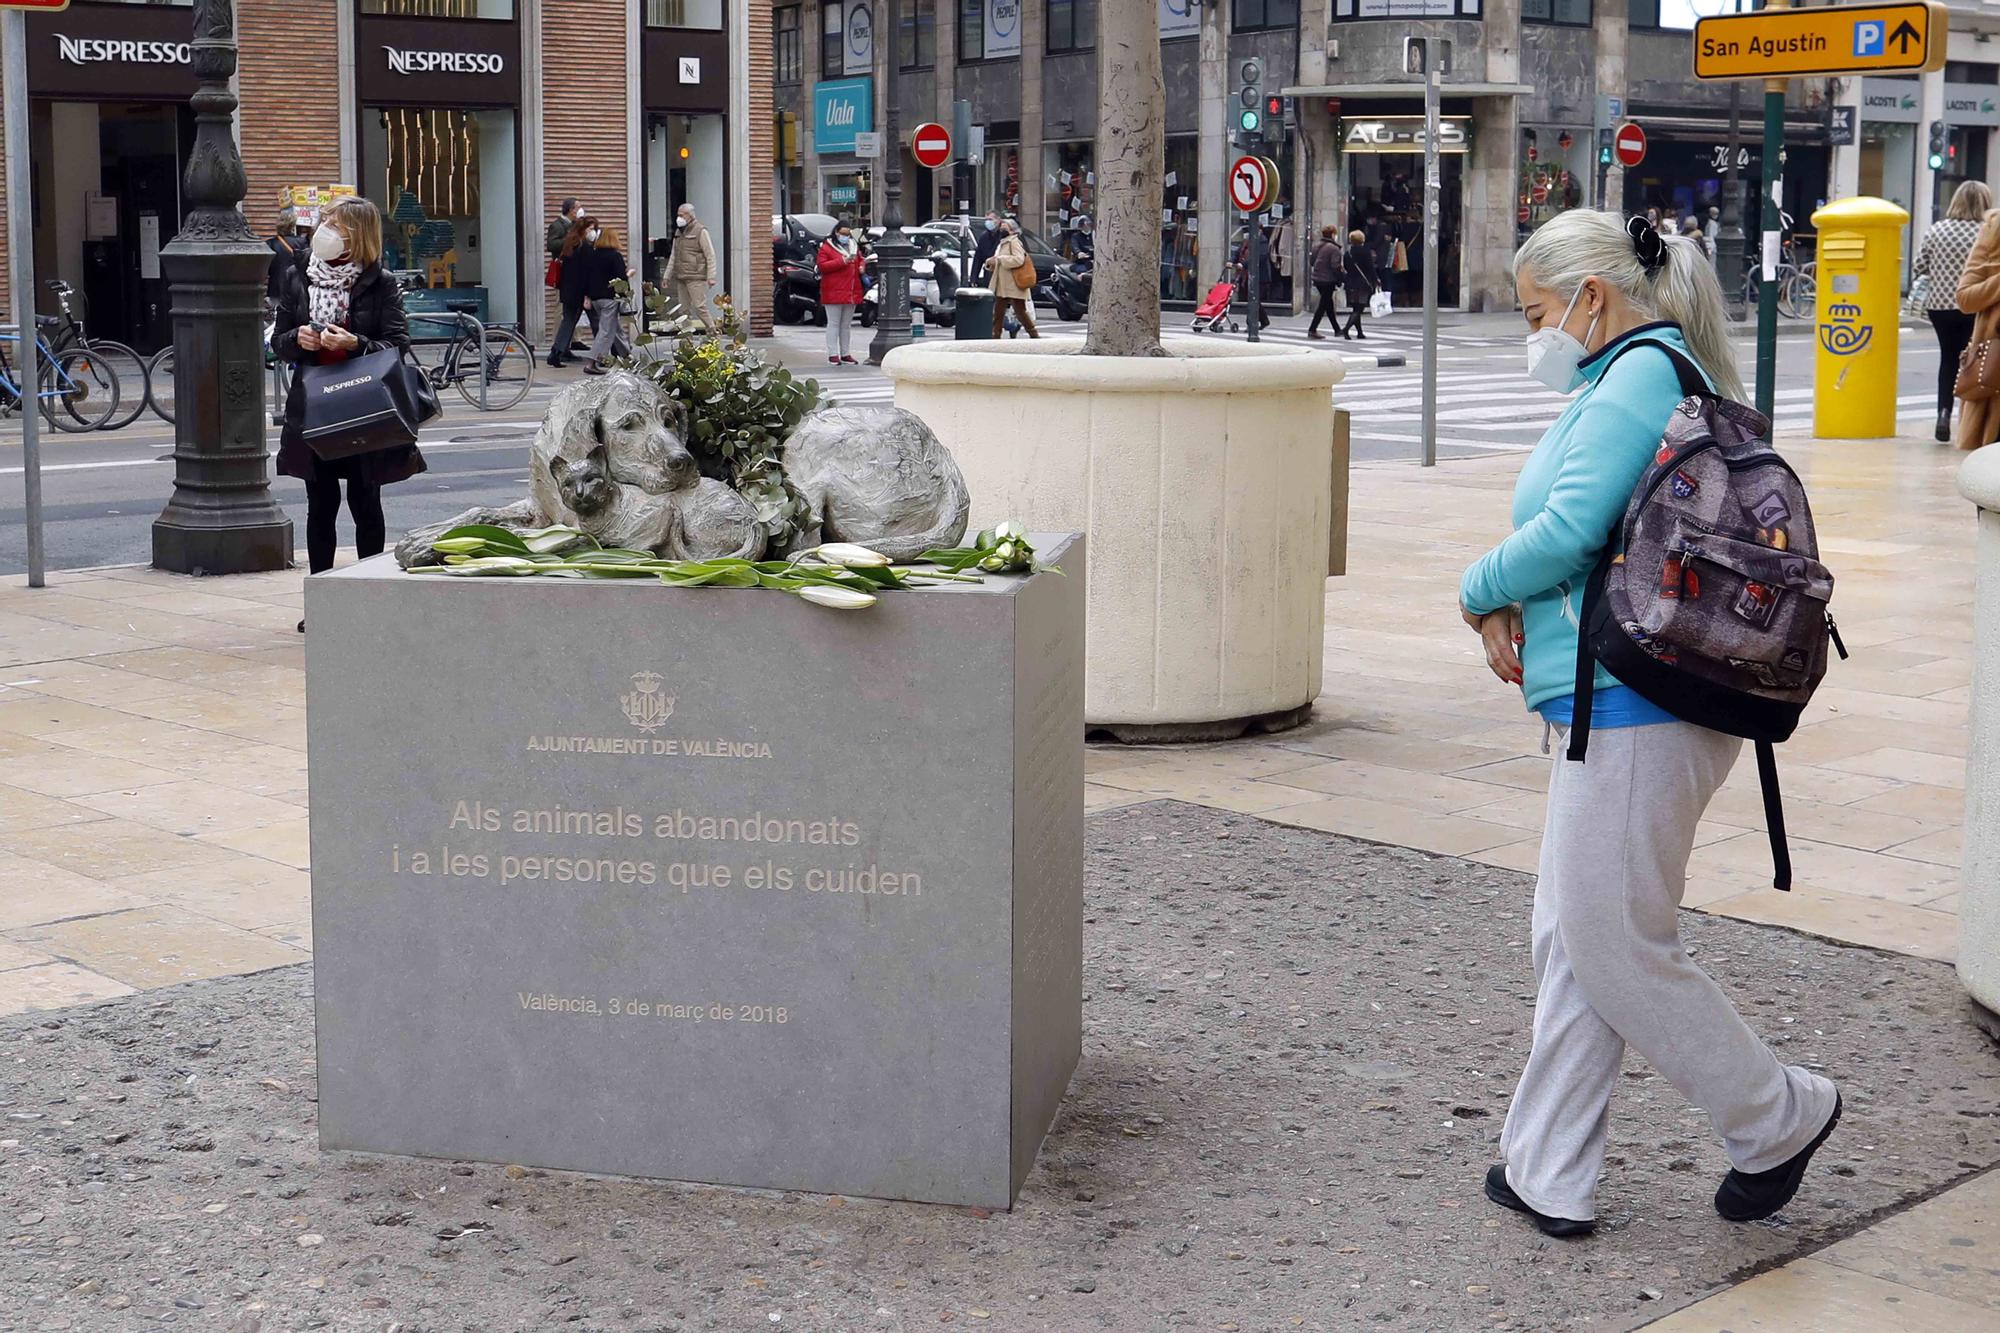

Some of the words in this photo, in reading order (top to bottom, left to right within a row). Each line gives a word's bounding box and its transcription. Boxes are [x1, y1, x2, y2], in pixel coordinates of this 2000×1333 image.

[52, 33, 191, 65] NESPRESSO
[1702, 38, 1739, 57] San
[1748, 33, 1826, 57] Agustín
[1857, 24, 1879, 54] P
[381, 45, 503, 75] NESPRESSO
[826, 98, 855, 126] Uala
[1865, 95, 1896, 108] LACOSTE
[1946, 101, 1976, 112] LACOSTE
[831, 189, 856, 200] REBAJAS
[323, 375, 372, 394] NESPRESSO
[526, 735, 648, 755] AJUNTAMENT
[652, 740, 677, 756] DE
[681, 738, 773, 759] VALÈNCIA
[449, 799, 501, 832] Als
[512, 803, 643, 838] animals
[654, 808, 861, 846] abandonats
[392, 843, 400, 874] i
[411, 851, 432, 875] a
[443, 846, 490, 877] les
[501, 853, 656, 885] persones
[668, 861, 732, 894] que
[744, 859, 794, 891] els
[805, 862, 921, 896] cuiden
[518, 992, 602, 1016] València,
[608, 998, 621, 1015] 3
[626, 998, 650, 1016] de
[656, 1002, 703, 1023] març
[710, 1001, 734, 1021] de
[739, 1005, 788, 1024] 2018
